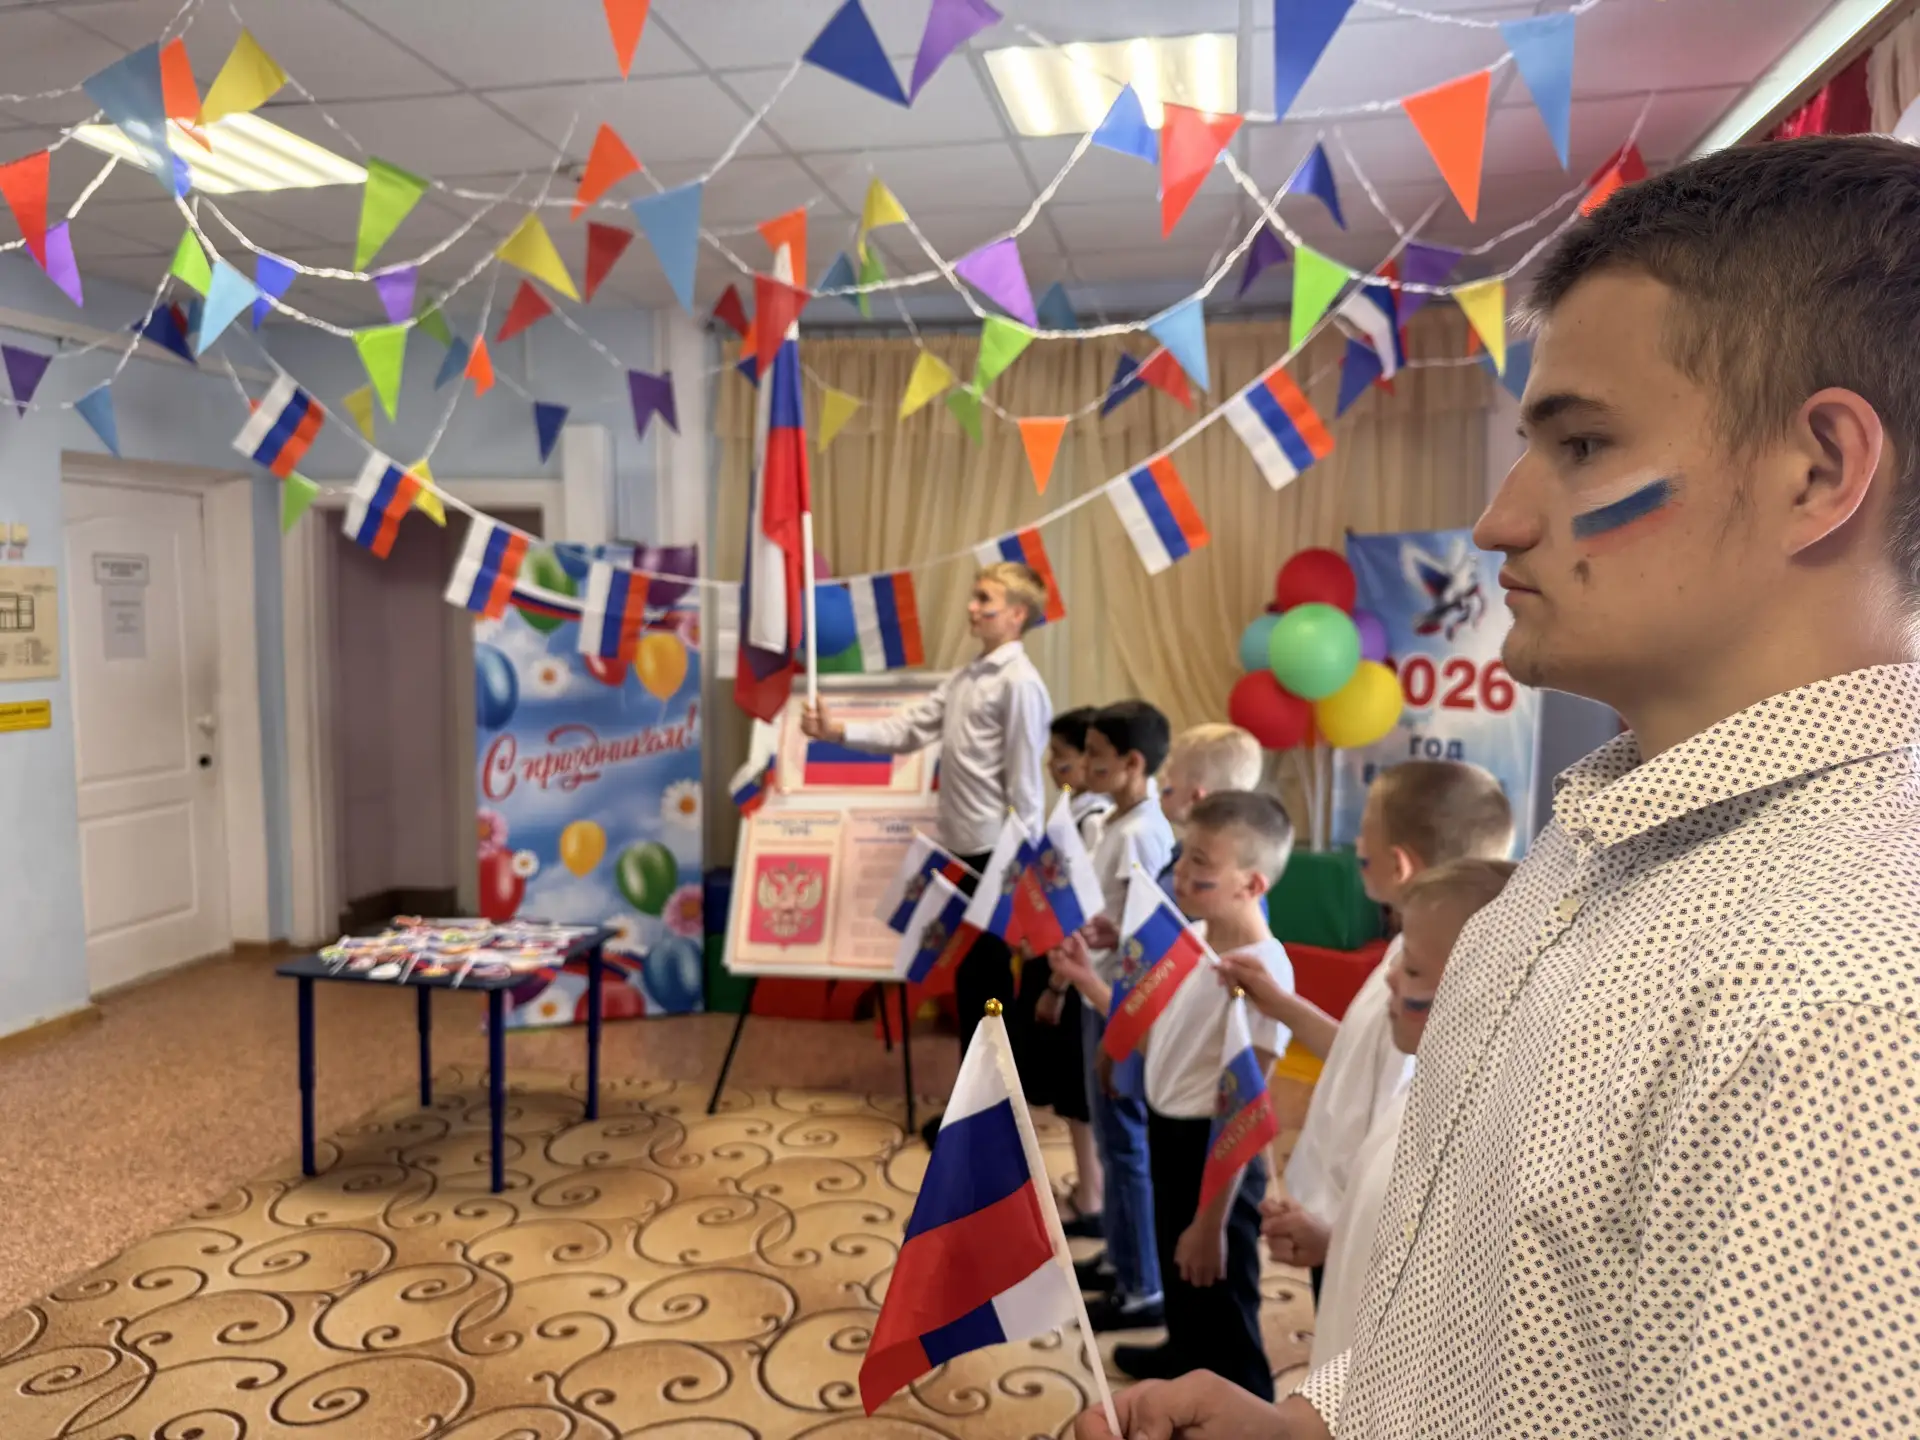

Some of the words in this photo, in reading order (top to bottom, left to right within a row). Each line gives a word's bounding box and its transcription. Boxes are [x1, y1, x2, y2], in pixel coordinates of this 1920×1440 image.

[1384, 655, 1516, 713] 026
[482, 732, 517, 802] С
[522, 703, 698, 792] праздником!
[1409, 733, 1465, 760] год
